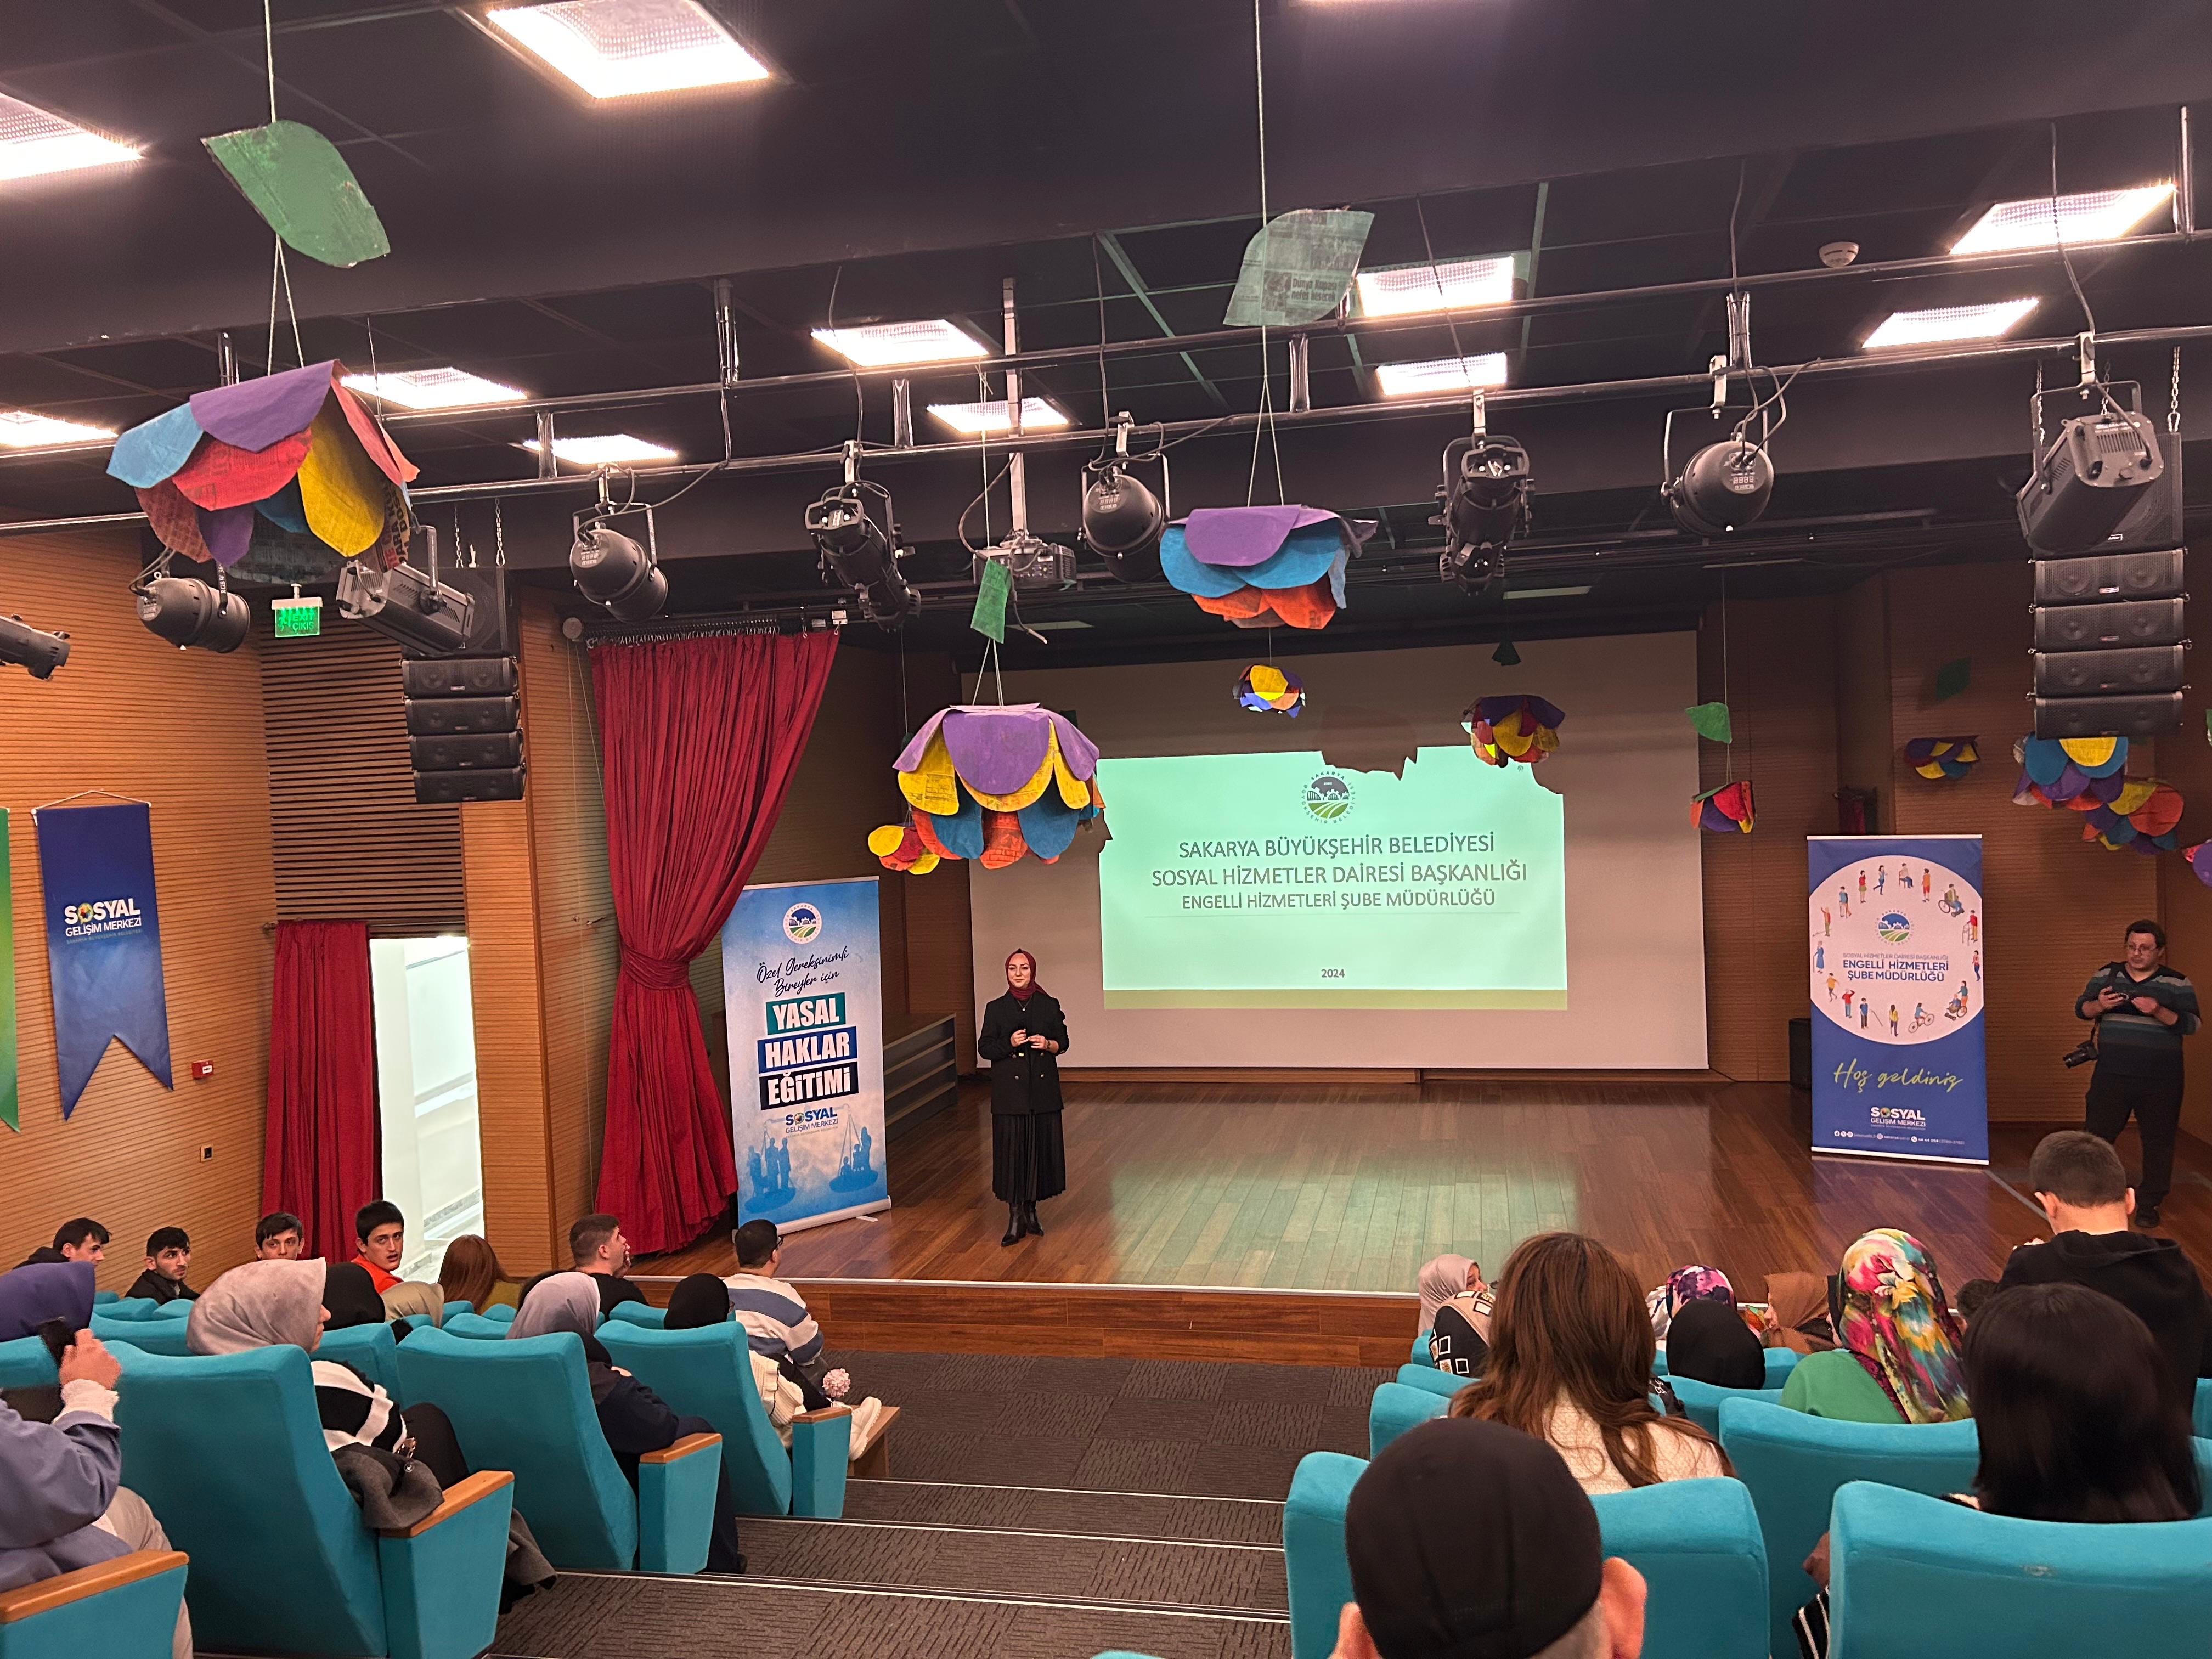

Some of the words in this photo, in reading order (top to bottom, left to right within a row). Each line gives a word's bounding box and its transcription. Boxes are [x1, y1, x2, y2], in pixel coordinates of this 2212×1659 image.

[292, 612, 315, 622] EXIT
[1179, 840, 1260, 858] SAKARYA
[1265, 834, 1383, 859] BÜYÜKŞEHİR
[1389, 831, 1494, 854] BELEDİYESİ
[1152, 868, 1218, 887] SOSYAL
[1223, 865, 1327, 884] HİZMETLER
[1333, 862, 1404, 883] DAİRESİ
[1412, 859, 1526, 885] BAŞKANLIĞI
[1182, 892, 1242, 909] ENGELLİ
[1247, 890, 1336, 908] HİZMETLERİ
[1341, 893, 1381, 910] ŞUBE
[1386, 888, 1495, 906] MÜDÜRLÜĞÜ
[64, 898, 141, 925] SOSYAL
[65, 922, 102, 937] GELİŞİM
[104, 915, 142, 932] MERKEZİ
[757, 962, 781, 983] Özel
[785, 945, 849, 977] Gereksinimli
[1321, 969, 1345, 979] 2024
[1843, 959, 1884, 969] ENGELLİ
[1889, 959, 1949, 971] HİZMETLERİ
[821, 970, 840, 984] için
[1847, 970, 1874, 981] ŞUBE
[1876, 969, 1944, 982] MÜDÜRLÜĞÜ
[772, 997, 840, 1030] YASAL
[765, 1032, 850, 1069] HAKLAR
[768, 1066, 850, 1105] EĞİTİMİ
[1833, 1058, 1872, 1093] Hoş
[1877, 1067, 1963, 1093] geldiniz
[785, 1107, 838, 1126] SOSYAL
[1871, 1106, 1926, 1121] SOSYAL
[785, 1124, 810, 1133] GELİŞİM
[812, 1118, 838, 1128] MERKEZİ
